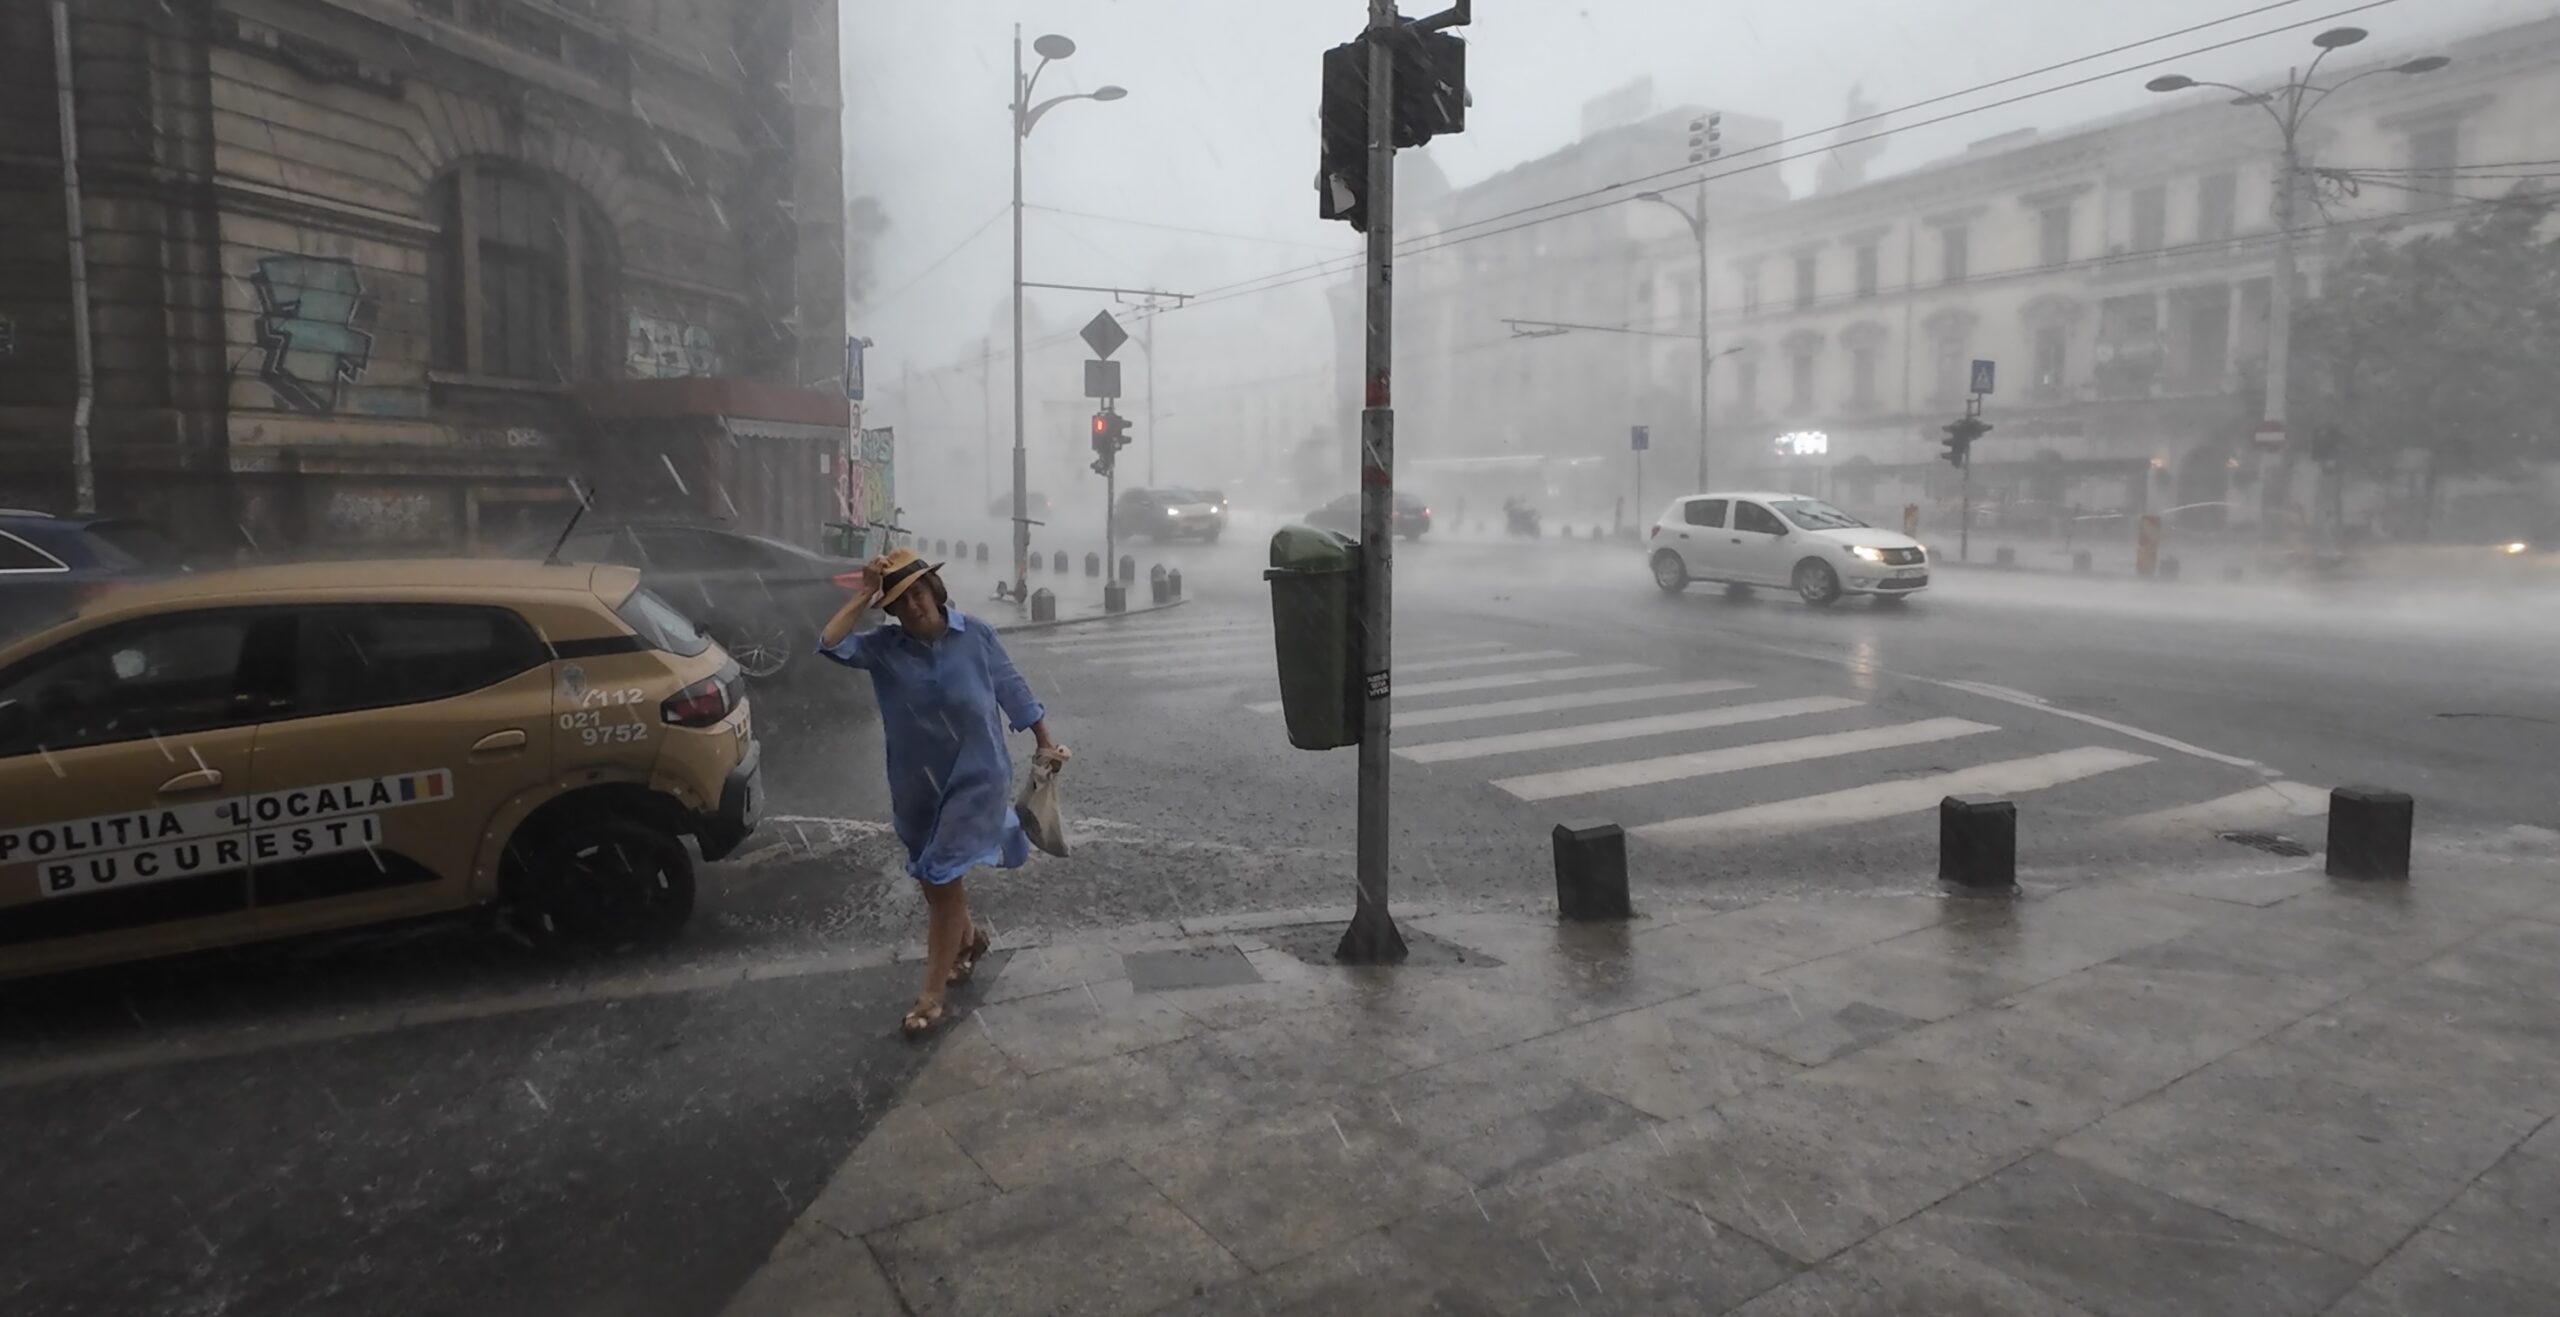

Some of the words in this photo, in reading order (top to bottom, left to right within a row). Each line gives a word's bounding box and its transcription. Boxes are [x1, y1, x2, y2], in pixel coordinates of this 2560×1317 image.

[597, 688, 645, 706] 112
[559, 711, 601, 730] 021
[583, 723, 648, 746] 9752
[230, 777, 392, 826] LOCALĂ
[48, 818, 373, 891] BUCUREȘTI
